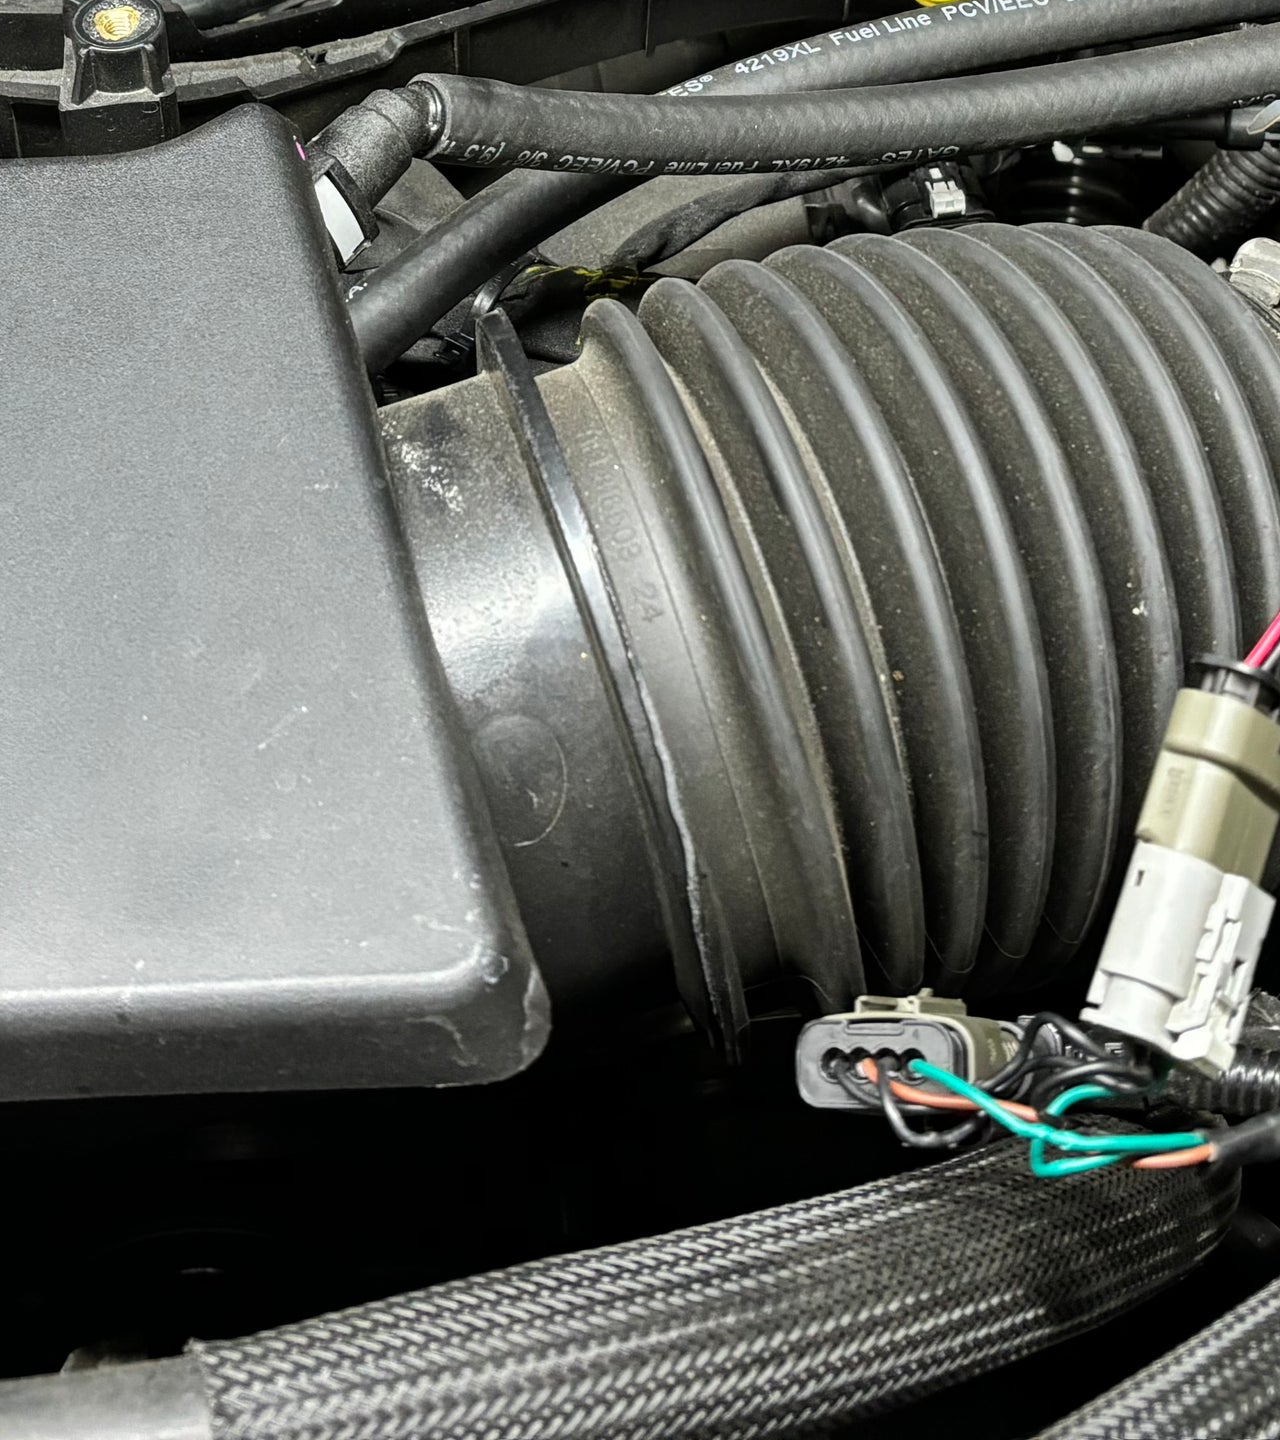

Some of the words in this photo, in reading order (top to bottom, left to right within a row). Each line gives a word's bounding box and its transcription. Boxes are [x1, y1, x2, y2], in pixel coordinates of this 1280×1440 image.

[735, 39, 821, 76] 4219XL
[829, 21, 881, 47] Fuel
[882, 11, 931, 34] Line
